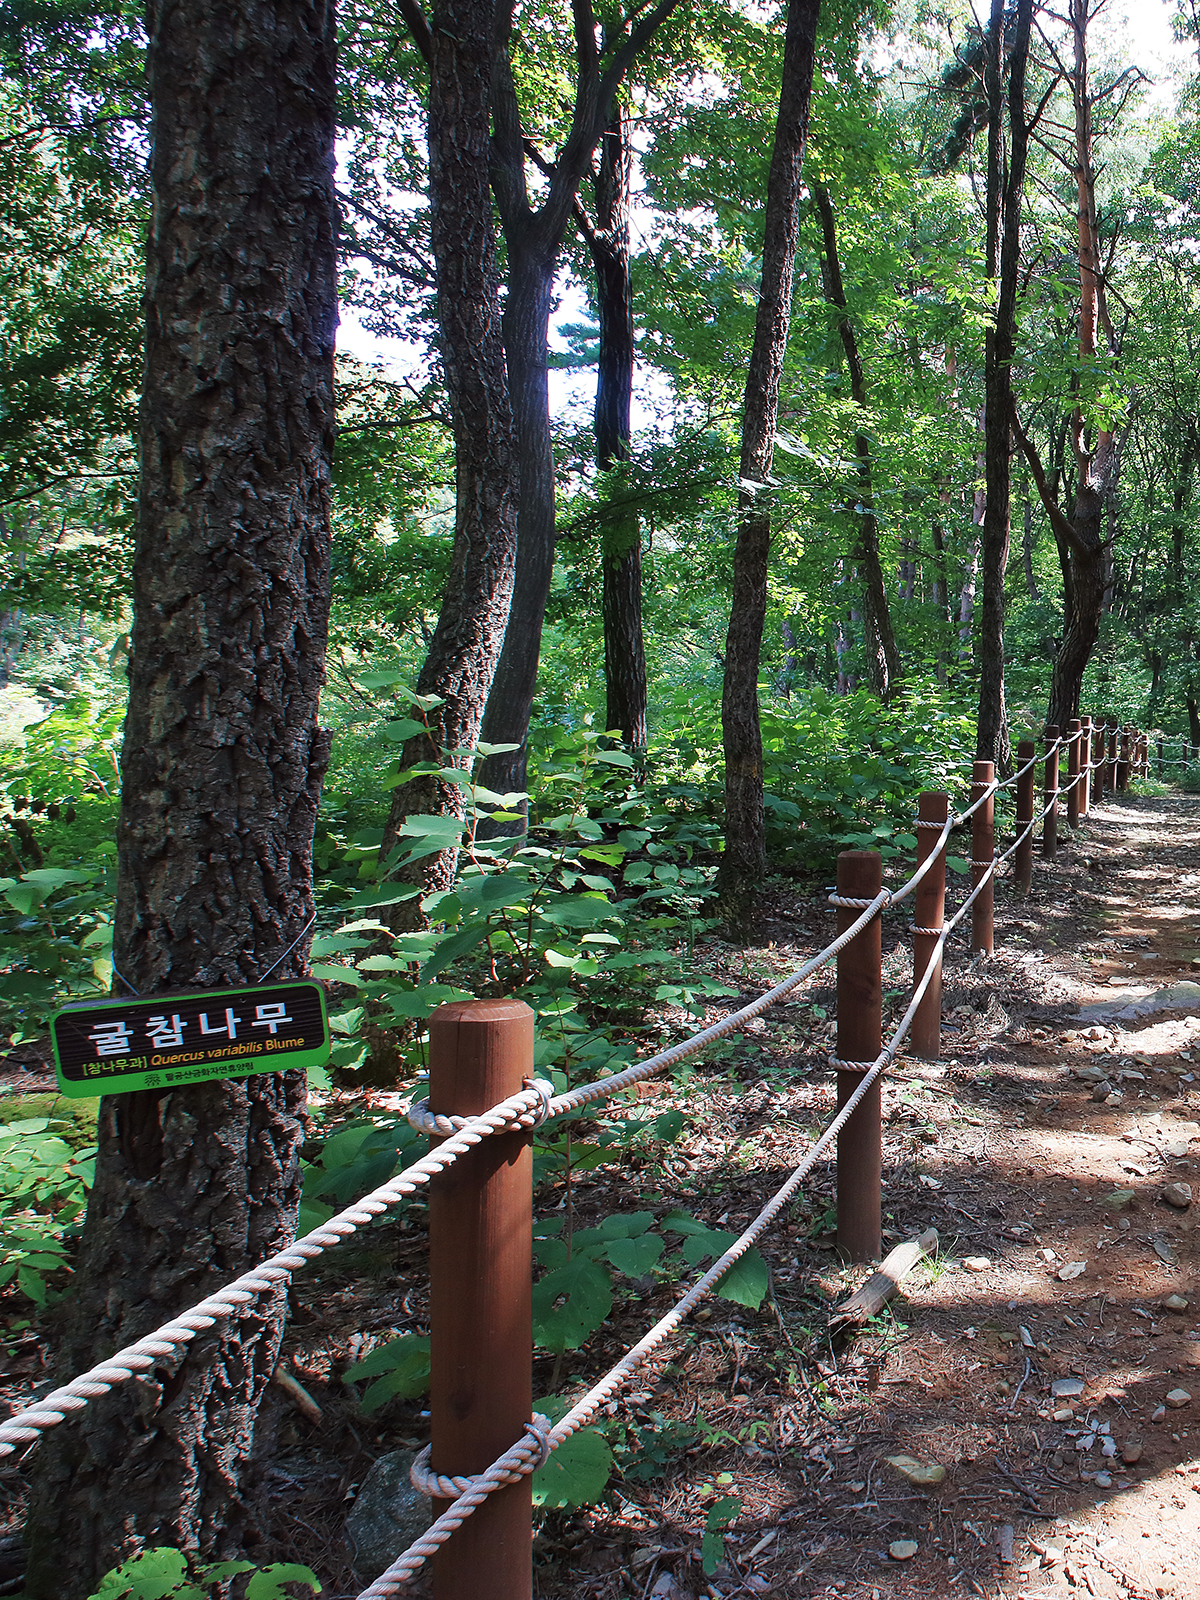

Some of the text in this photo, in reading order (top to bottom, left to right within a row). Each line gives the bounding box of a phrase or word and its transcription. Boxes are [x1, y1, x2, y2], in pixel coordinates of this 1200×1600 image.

[88, 1002, 293, 1056] 굴참나무
[151, 1050, 204, 1067] Quercus
[206, 1042, 263, 1059] variabilis
[265, 1036, 305, 1051] Blume
